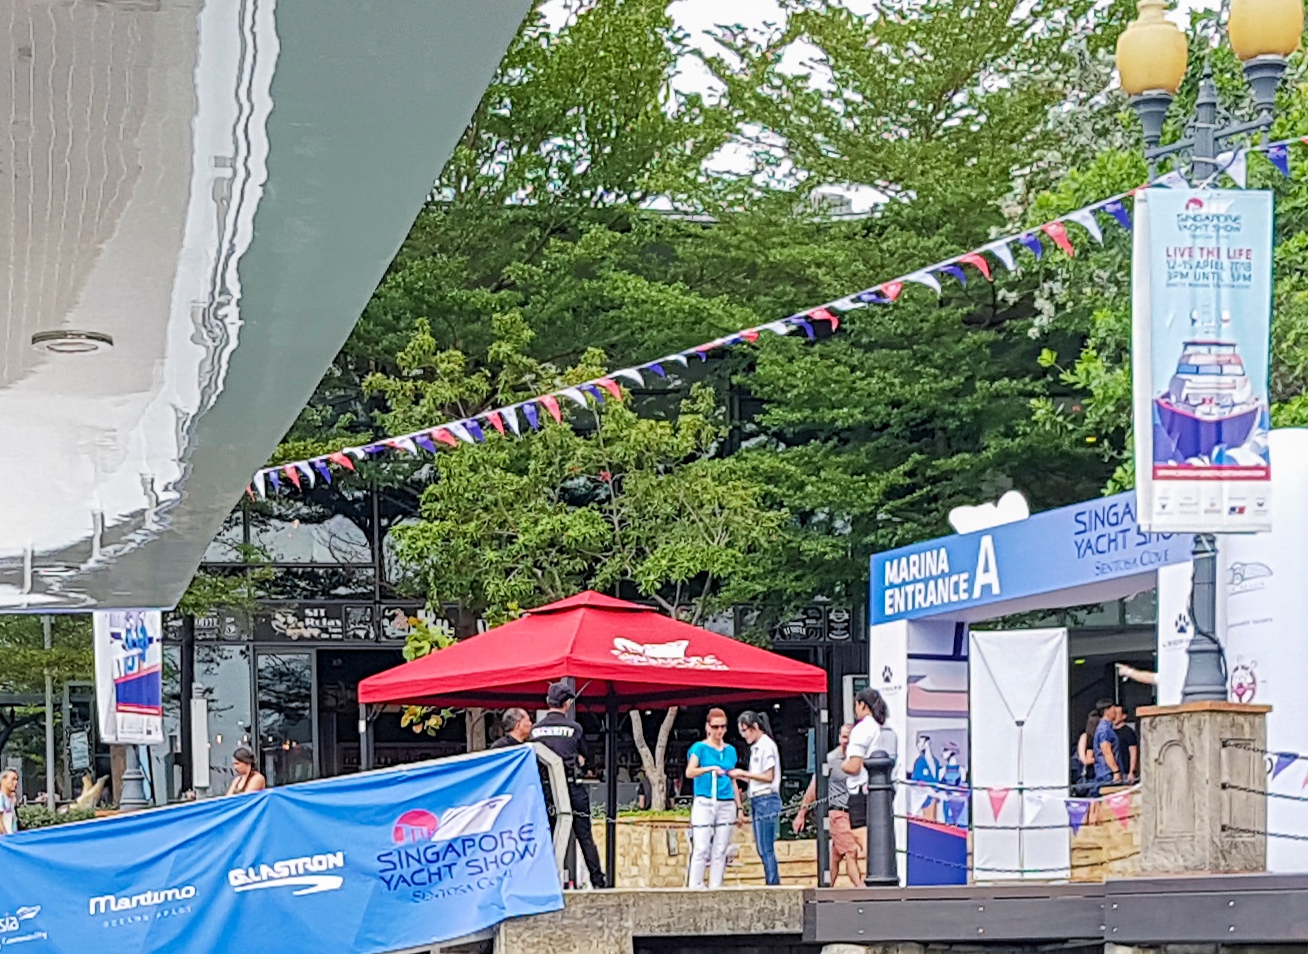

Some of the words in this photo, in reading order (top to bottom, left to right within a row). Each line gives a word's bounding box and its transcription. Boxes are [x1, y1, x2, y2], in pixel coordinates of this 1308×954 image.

[1166, 246, 1194, 259] LIVE
[1199, 246, 1220, 260] THE
[1227, 247, 1252, 260] LIFE
[1074, 502, 1136, 535] SINGA
[1074, 528, 1131, 560] YACHT
[884, 572, 970, 616] ENTRANCE
[972, 534, 1001, 599] A
[885, 547, 949, 586] MARINA
[377, 823, 536, 873] SINGAPORE
[228, 851, 344, 886] GLASTRON
[379, 863, 457, 891] YACHT
[466, 843, 537, 876] SHOW
